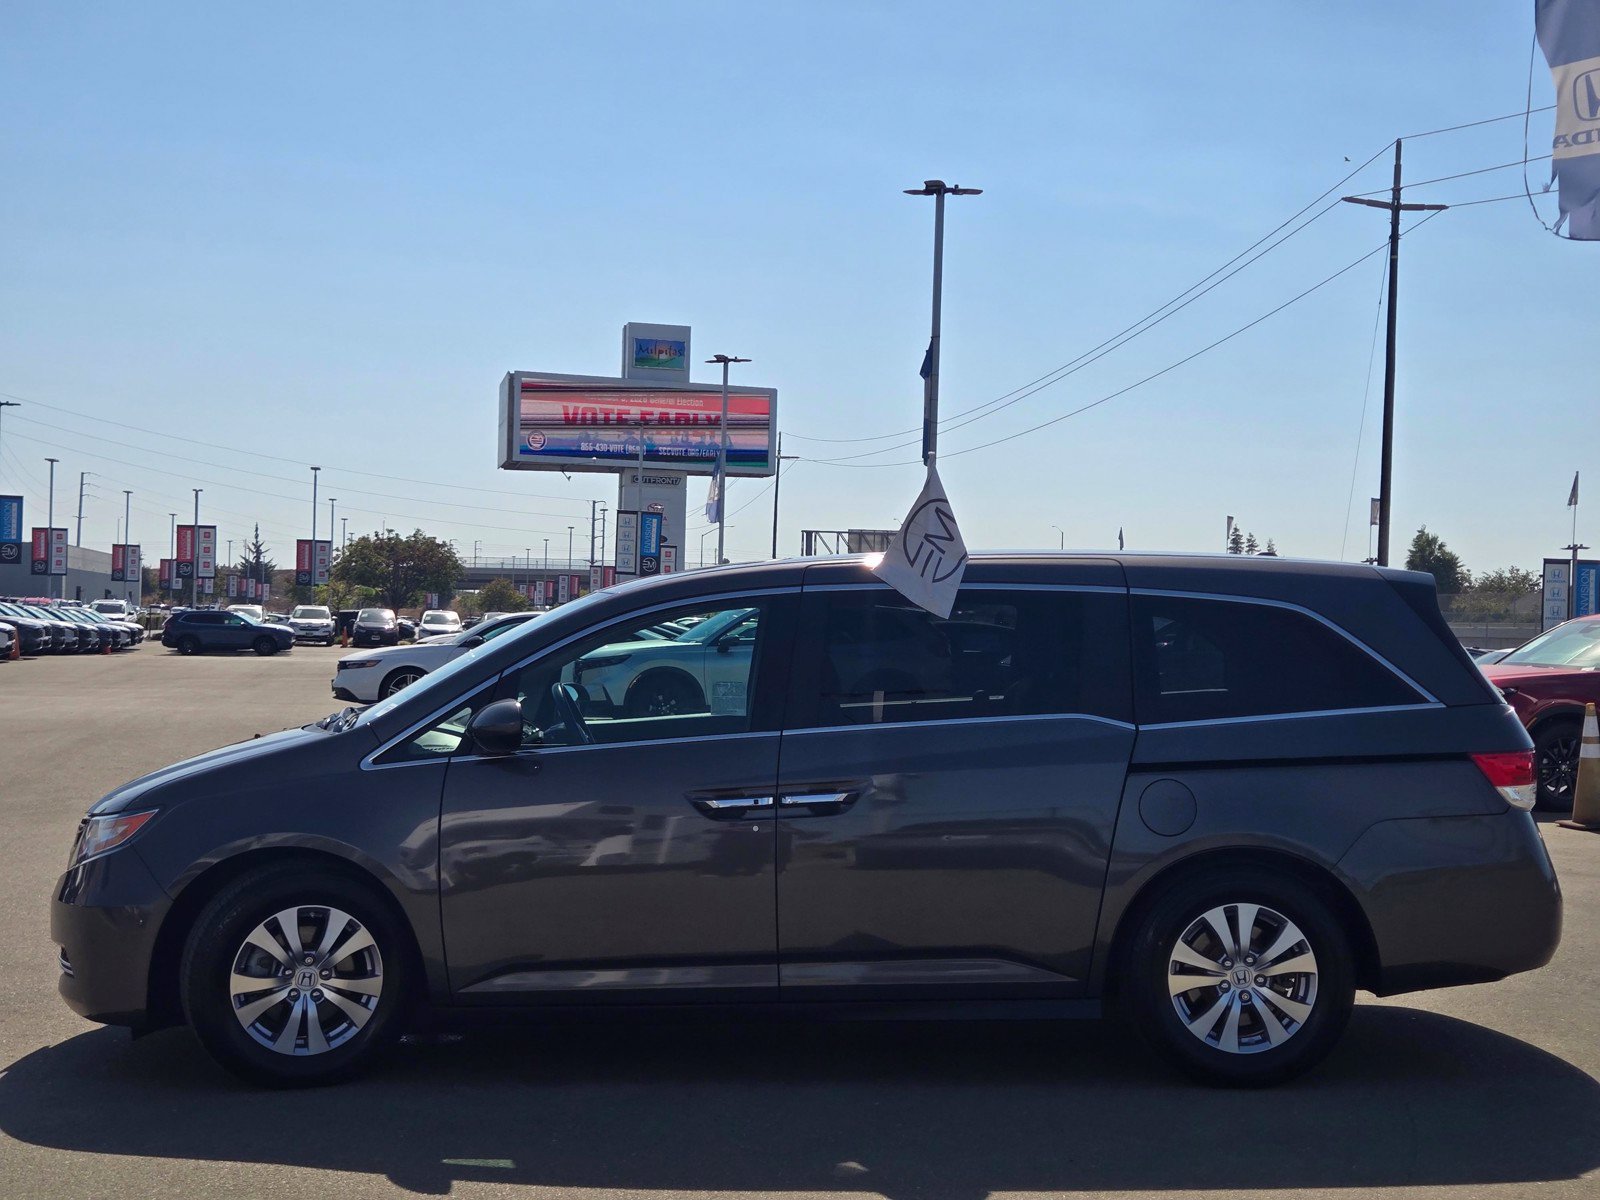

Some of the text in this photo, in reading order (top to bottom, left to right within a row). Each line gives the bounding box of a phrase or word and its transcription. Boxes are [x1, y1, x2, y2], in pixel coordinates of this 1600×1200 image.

[637, 341, 683, 360] Milpitas
[562, 405, 722, 426] VOTE EARLY
[676, 398, 704, 407] Election
[3, 502, 12, 540] ENVISION
[644, 518, 652, 554] ENVISION
[1580, 569, 1589, 616] ENVISION
